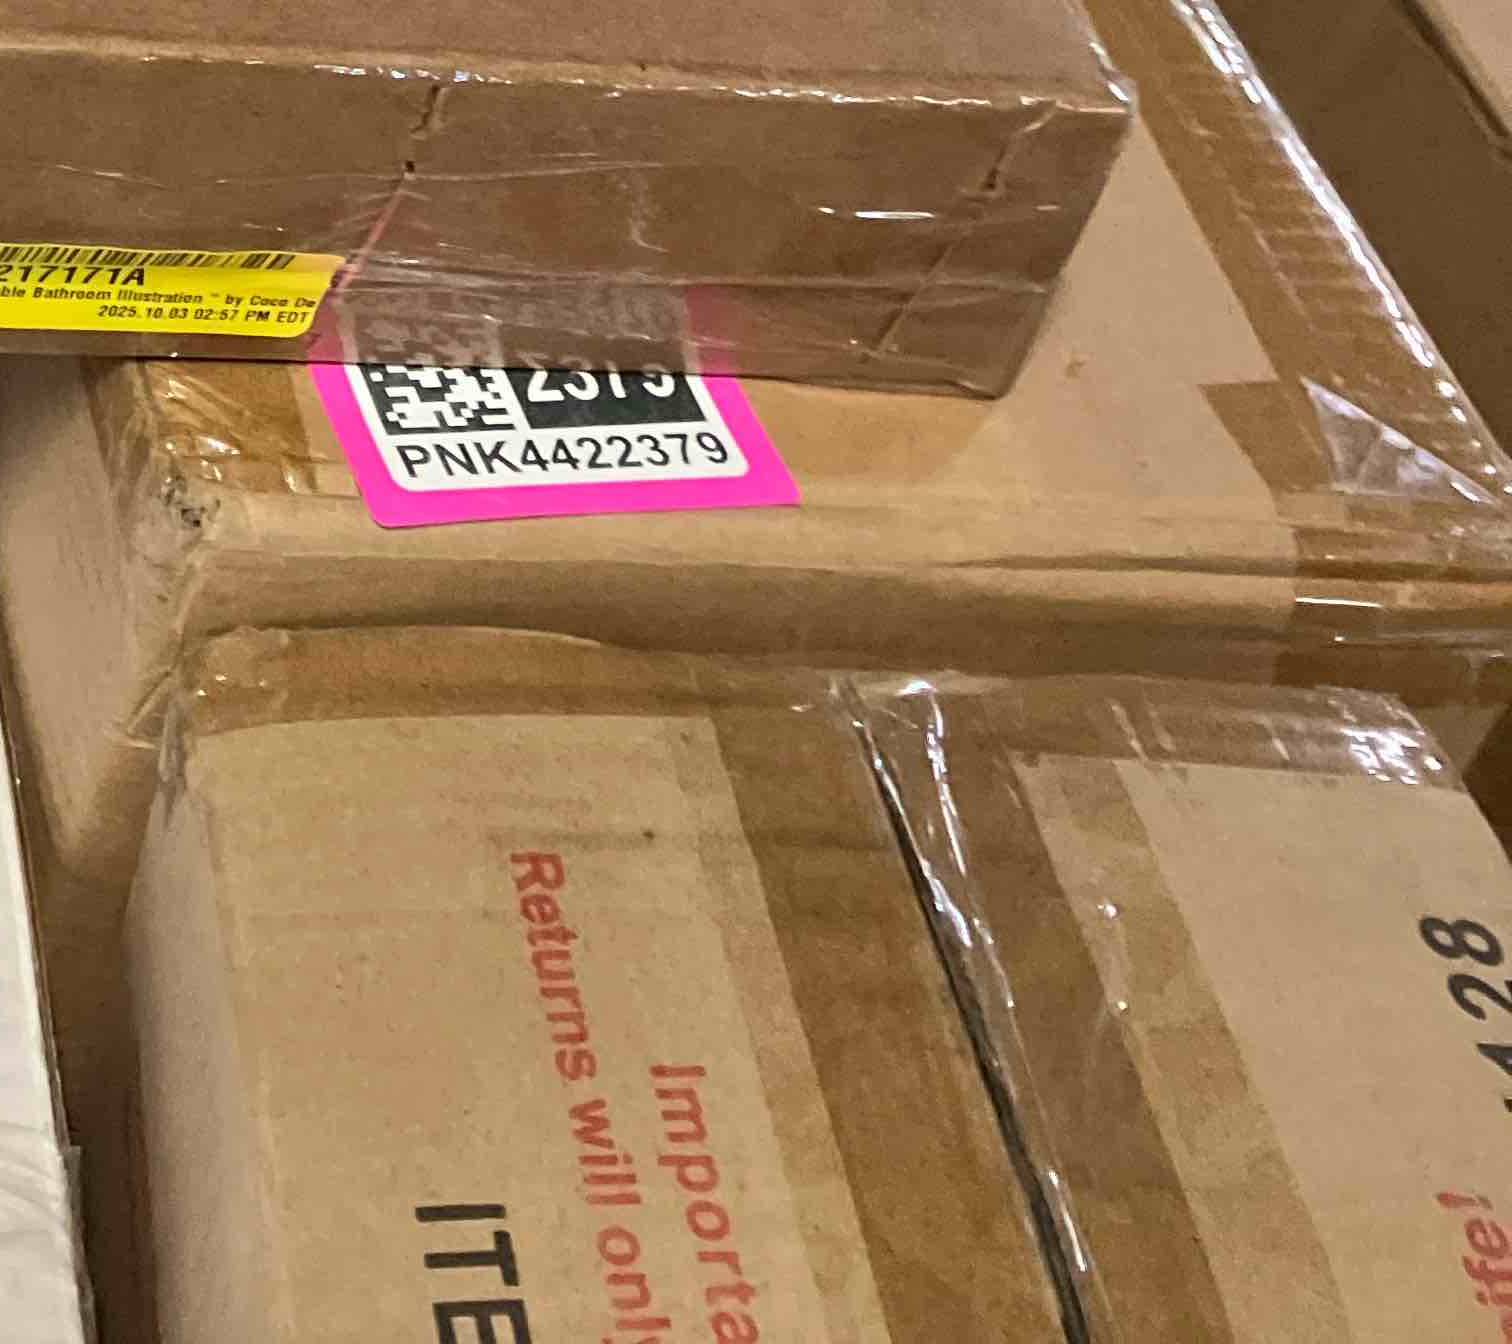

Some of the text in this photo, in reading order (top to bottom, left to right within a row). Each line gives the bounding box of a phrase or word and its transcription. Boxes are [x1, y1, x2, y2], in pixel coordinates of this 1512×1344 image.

[32, 287, 111, 301] Bathroom
[117, 288, 203, 304] Illustration
[225, 293, 244, 307] by
[245, 310, 270, 323] PM
[277, 311, 308, 324] EDT
[395, 432, 729, 479] PNK4422379
[510, 851, 672, 1344] Returns will onl
[650, 1064, 760, 1344] Importa
